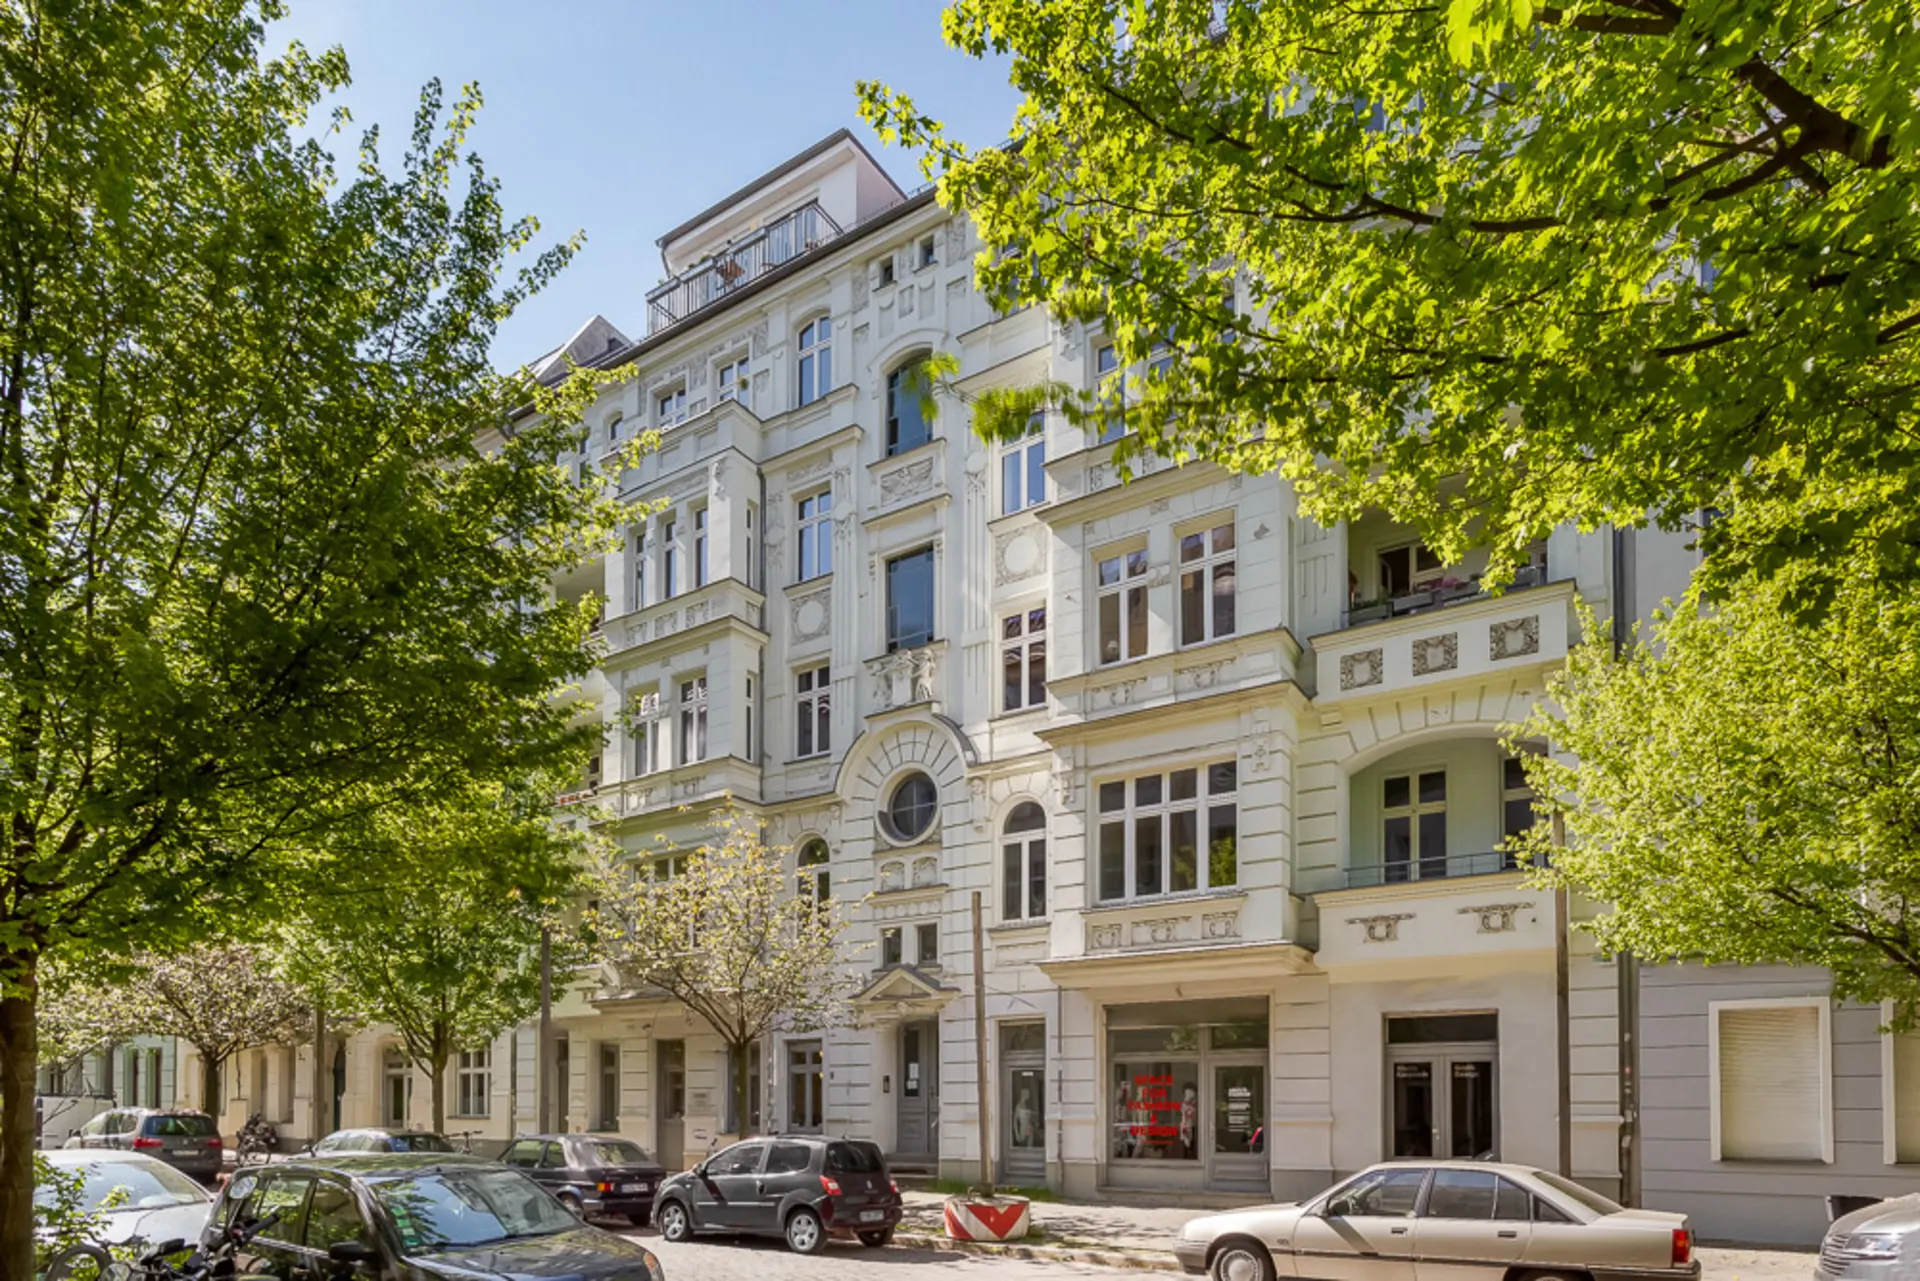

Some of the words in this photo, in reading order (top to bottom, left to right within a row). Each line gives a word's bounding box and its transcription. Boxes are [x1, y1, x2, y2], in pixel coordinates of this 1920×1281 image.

[1134, 1075, 1173, 1086] SPACE
[1142, 1088, 1167, 1098] FOR
[1128, 1101, 1181, 1111] FASHION
[1130, 1125, 1177, 1136] DESIGN
